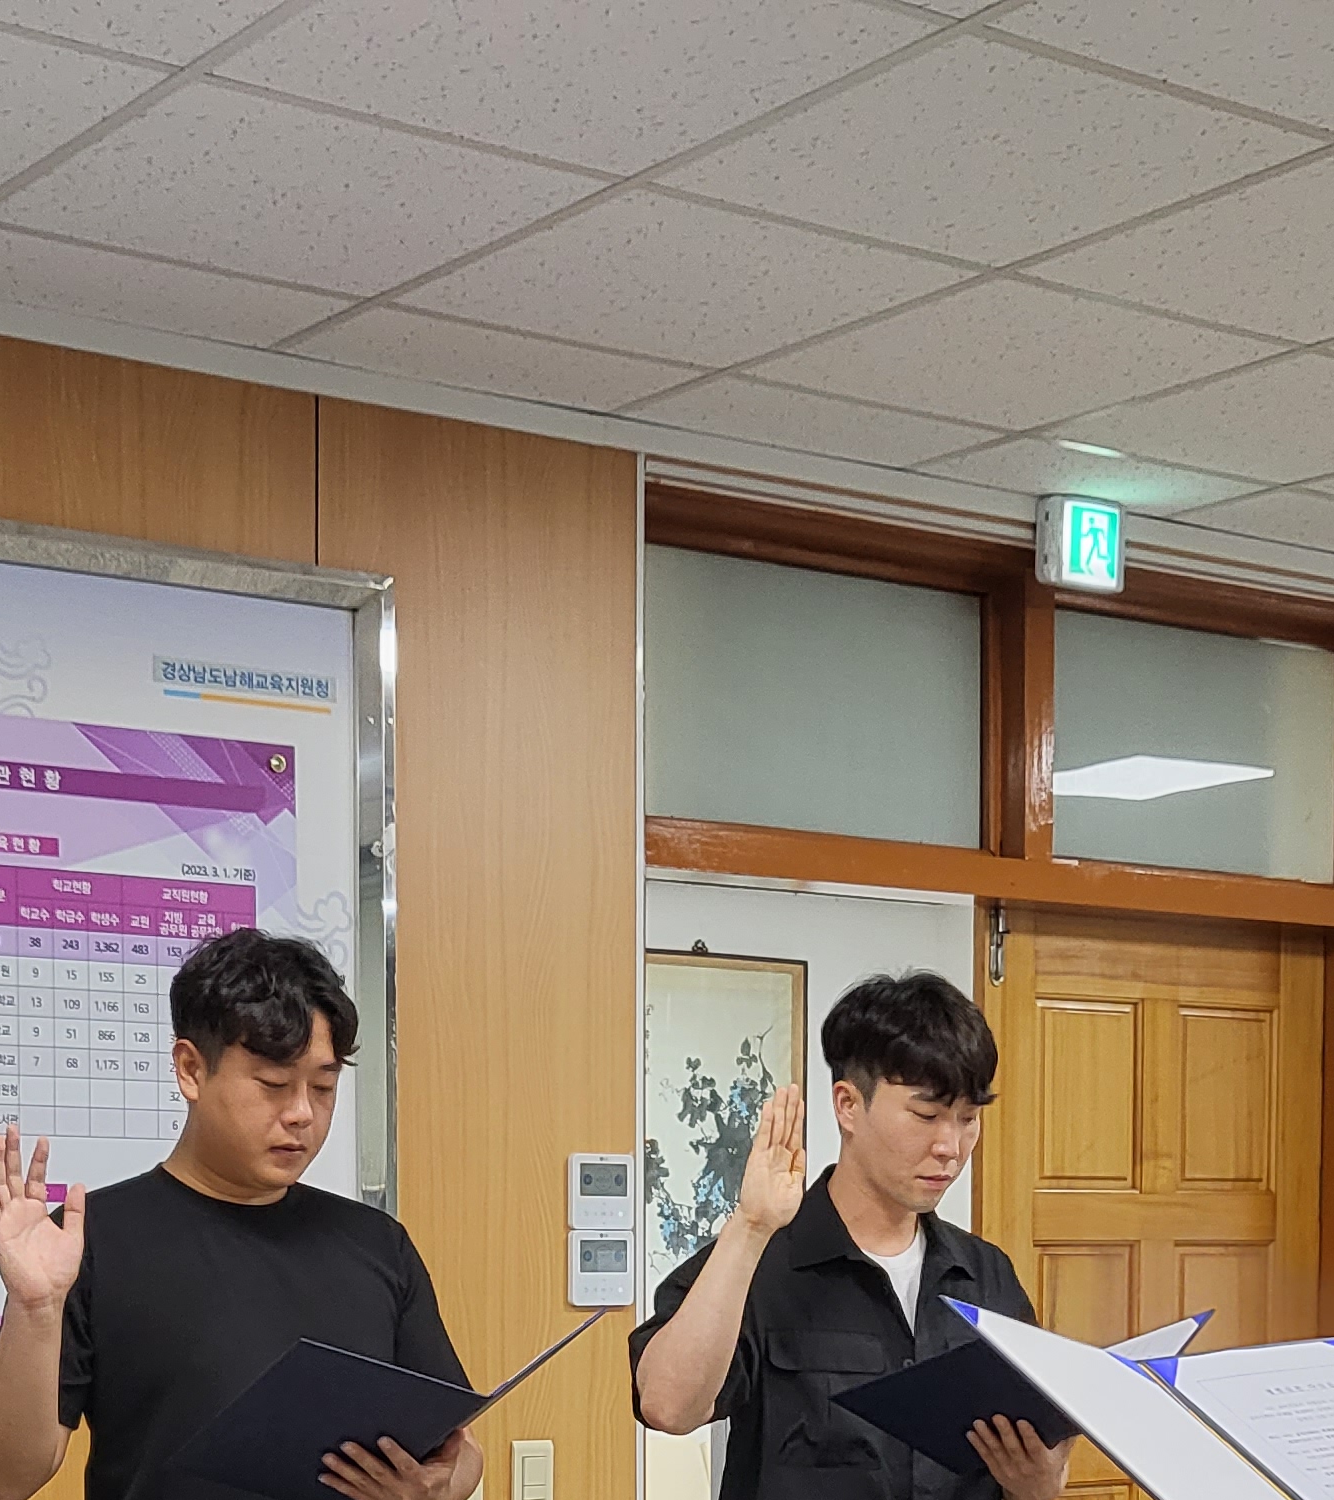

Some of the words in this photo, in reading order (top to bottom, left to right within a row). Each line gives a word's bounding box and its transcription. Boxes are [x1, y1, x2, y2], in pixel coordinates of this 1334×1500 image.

[162, 661, 329, 698] 경상남도남해교육지원청
[32, 968, 39, 978] 9
[30, 997, 42, 1007] 13
[33, 1027, 40, 1037] 9
[33, 1056, 40, 1066] 7
